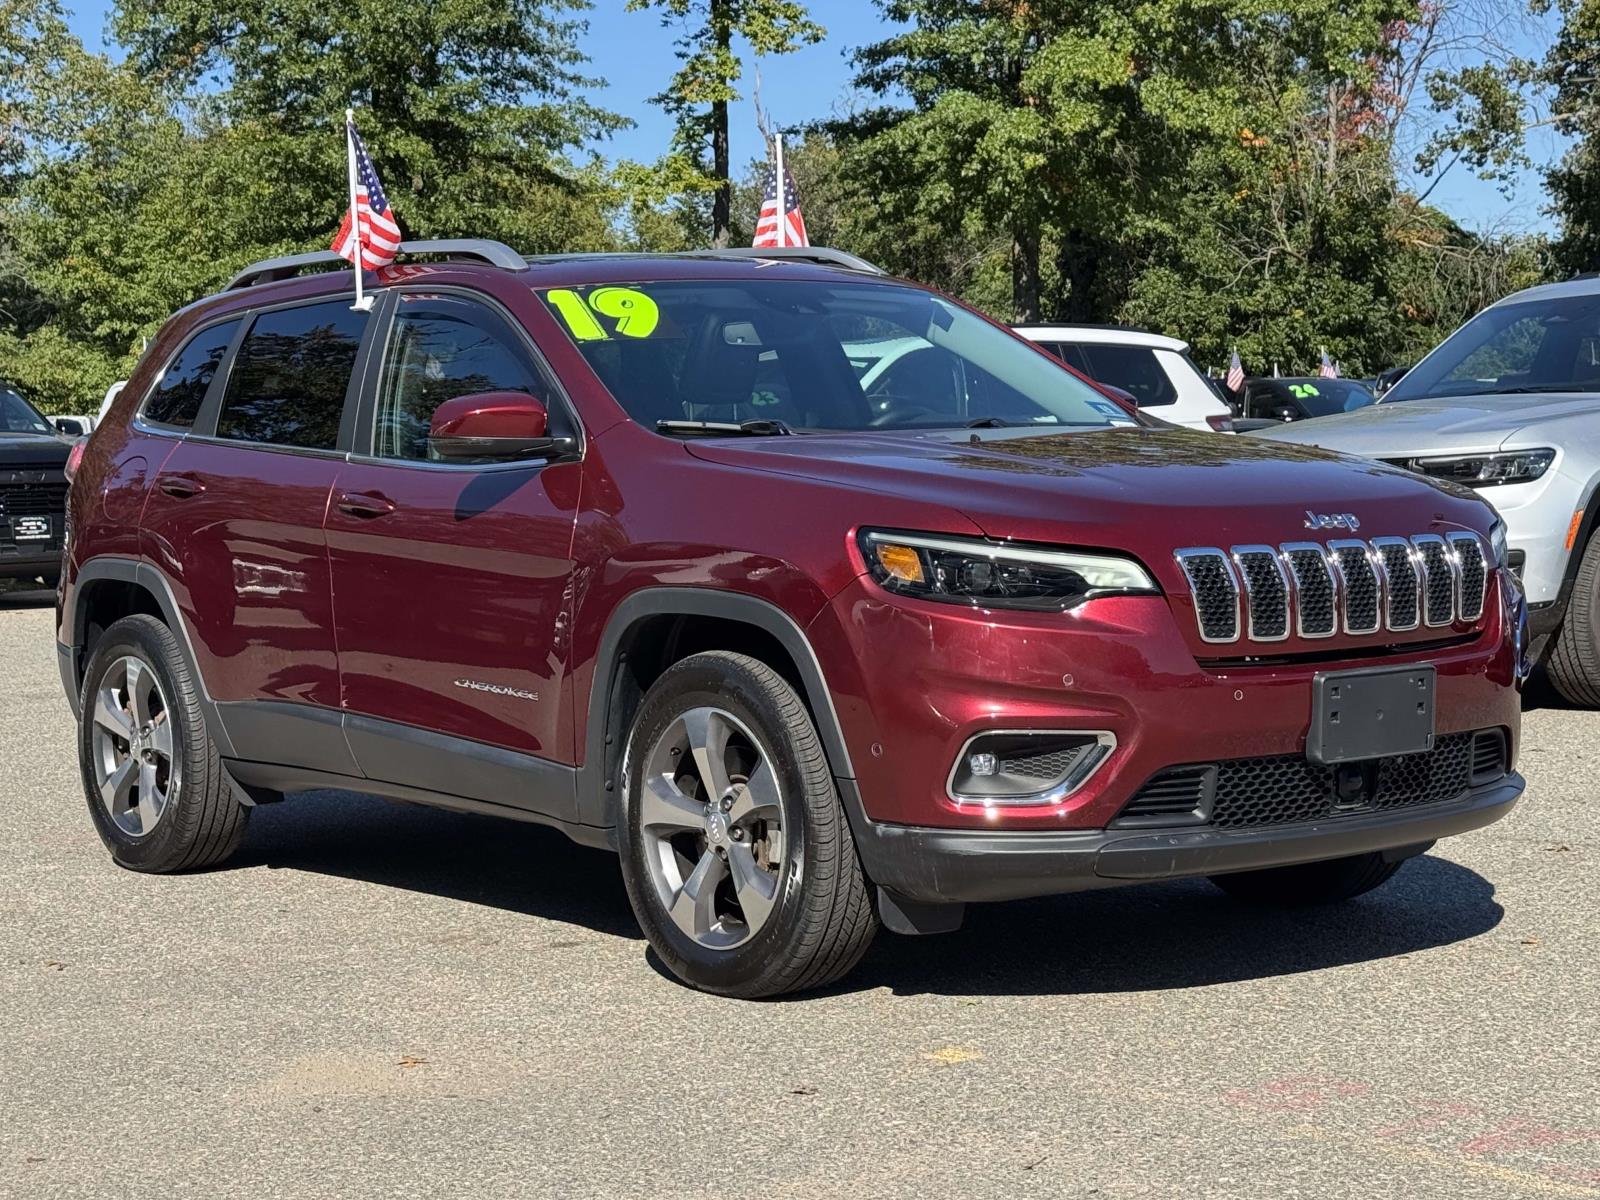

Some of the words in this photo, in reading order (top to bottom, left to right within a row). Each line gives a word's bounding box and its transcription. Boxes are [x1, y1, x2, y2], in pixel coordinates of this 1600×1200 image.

[547, 287, 659, 340] 19
[1304, 510, 1360, 532] Jeep
[453, 679, 539, 700] CHEROKEE
